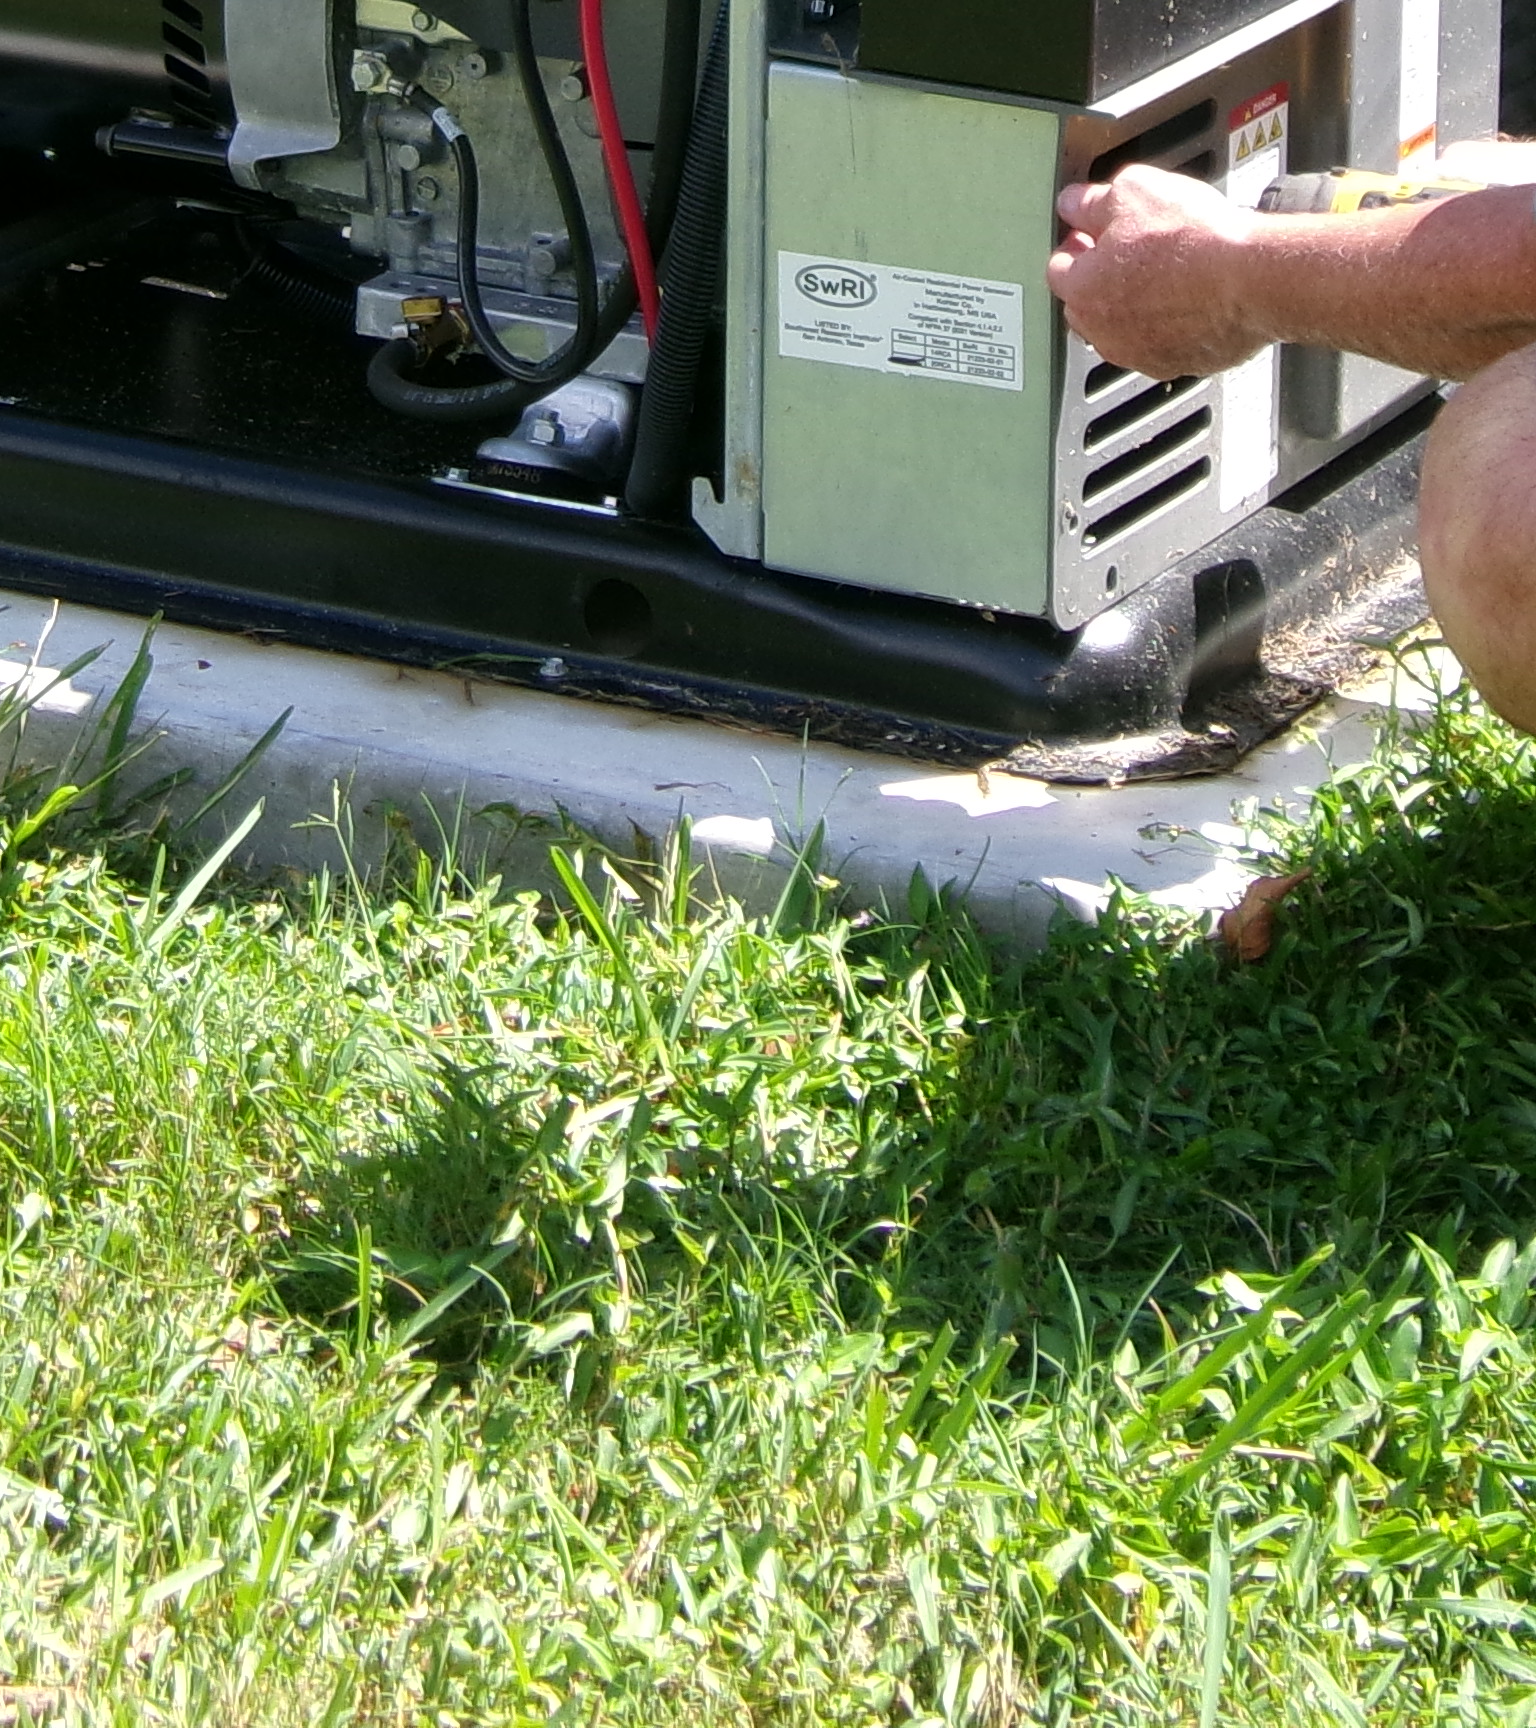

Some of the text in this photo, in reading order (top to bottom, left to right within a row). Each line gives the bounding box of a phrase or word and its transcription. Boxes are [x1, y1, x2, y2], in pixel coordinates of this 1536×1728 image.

[804, 273, 865, 300] SwRI
[926, 278, 961, 288] Residential
[962, 282, 982, 291] Power
[983, 286, 1015, 296] Generator
[925, 288, 985, 304] Manufactured by
[980, 311, 997, 320] USA
[815, 320, 839, 329] LISTED
[953, 319, 976, 328] Section
[846, 339, 865, 348] Texas
